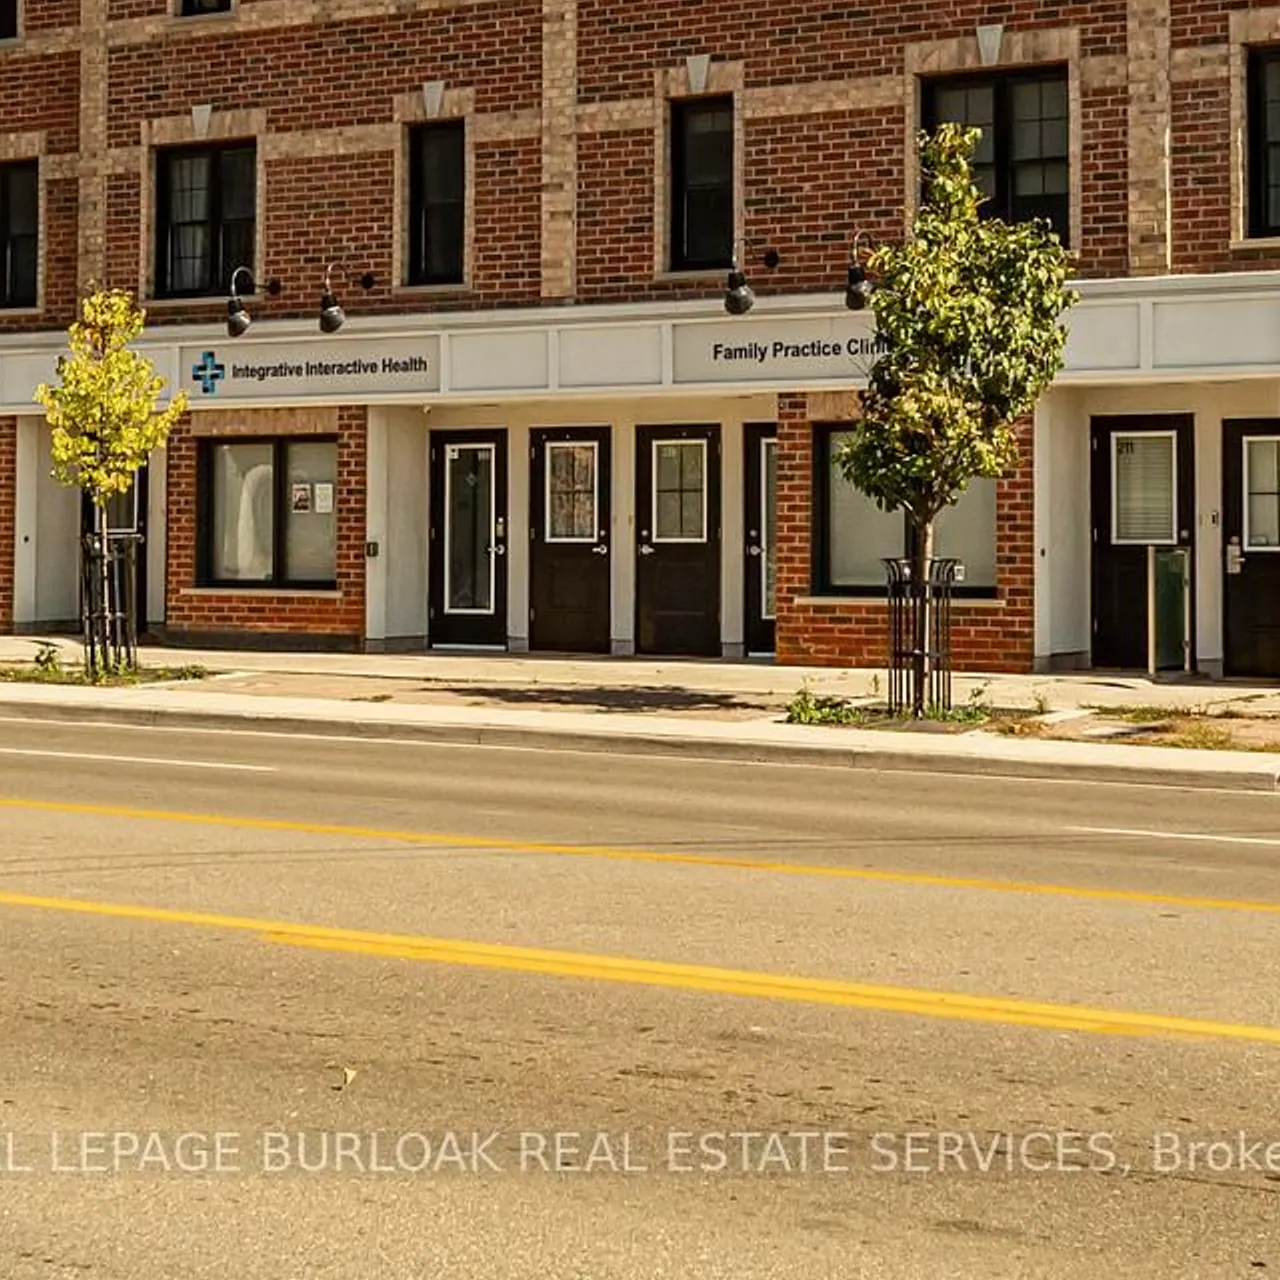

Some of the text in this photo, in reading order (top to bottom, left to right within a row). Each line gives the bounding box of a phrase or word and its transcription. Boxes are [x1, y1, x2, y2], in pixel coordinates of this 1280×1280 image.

[713, 343, 767, 363] Family
[772, 340, 842, 358] Practice
[232, 356, 428, 381] Integrative Interactive Health
